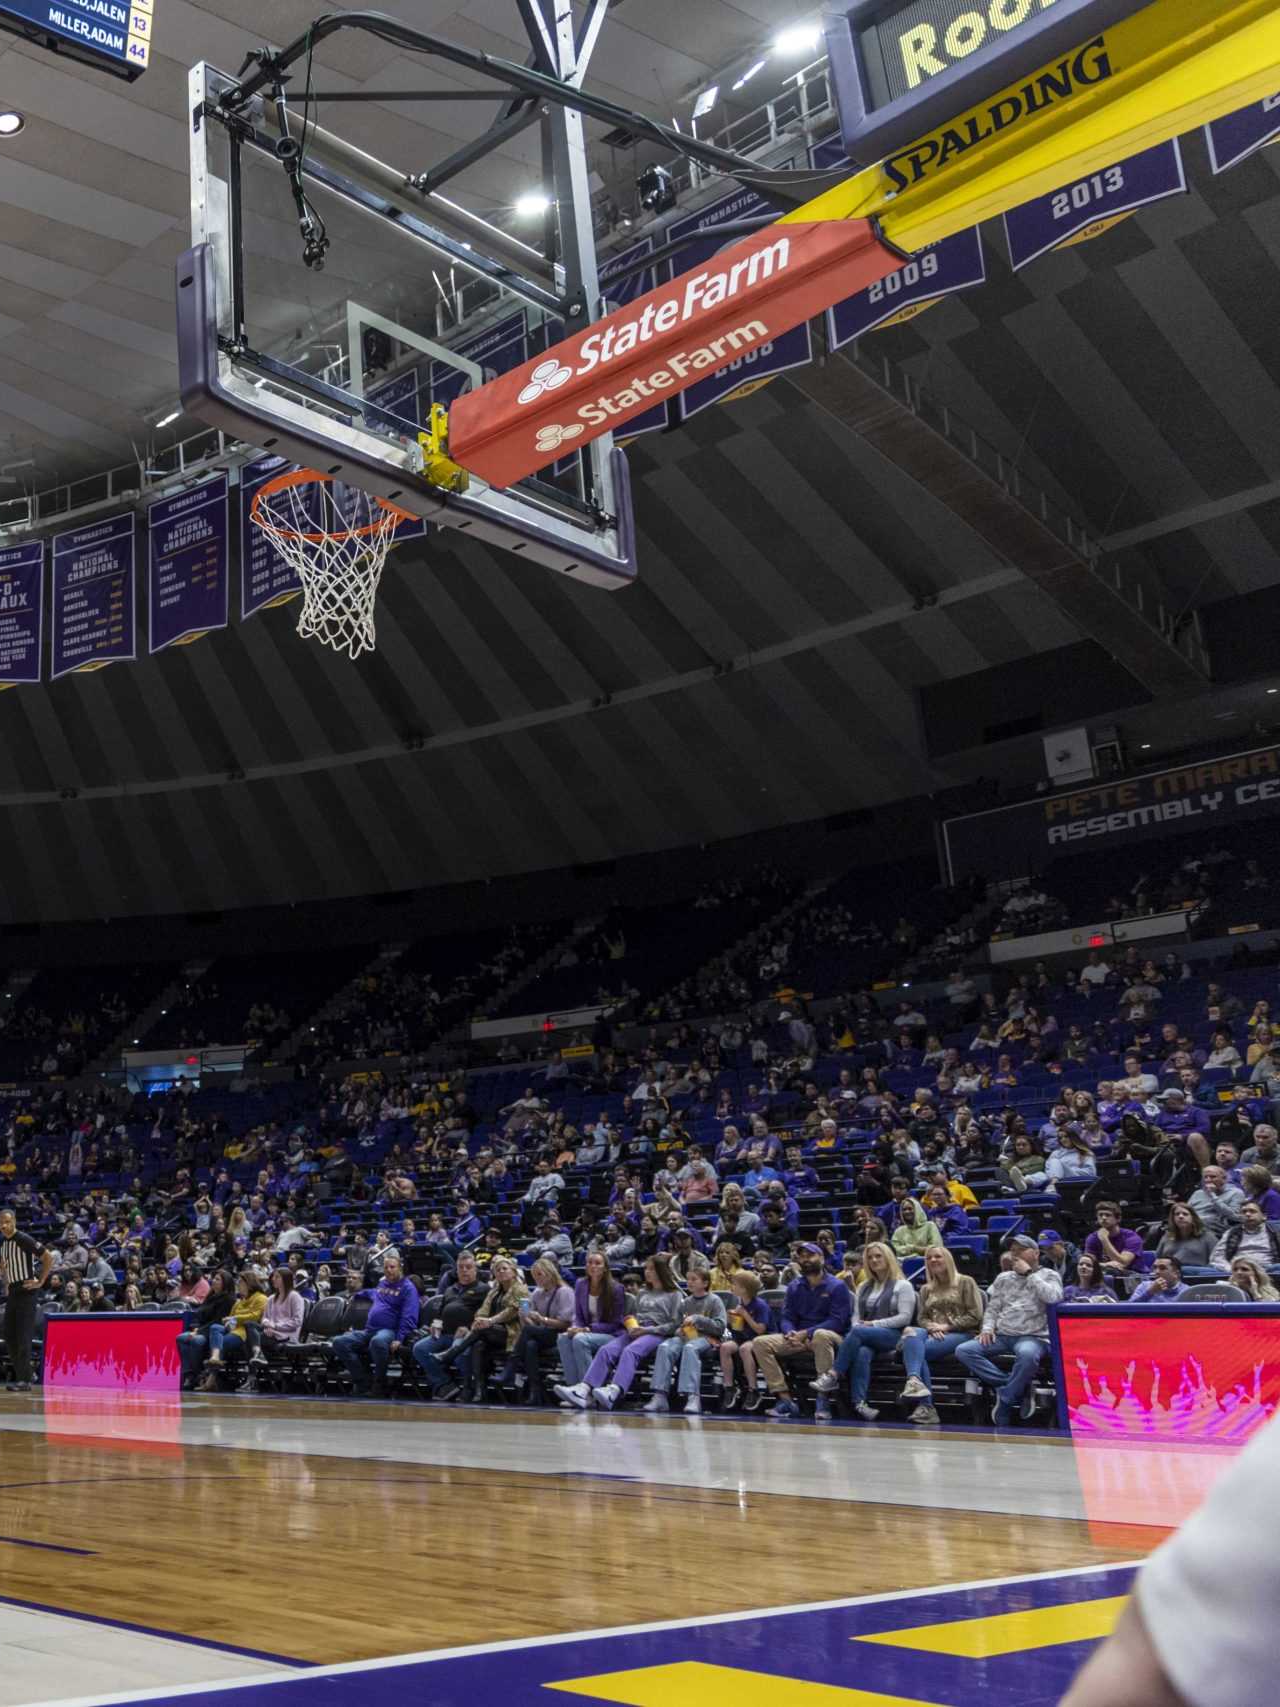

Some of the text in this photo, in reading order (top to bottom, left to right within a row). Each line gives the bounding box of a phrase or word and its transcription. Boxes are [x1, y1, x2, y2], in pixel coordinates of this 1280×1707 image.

[49, 8, 124, 50] MILLER,ADAM
[133, 16, 147, 31] 13
[129, 44, 145, 59] 44
[899, 0, 1058, 89] Roo
[881, 36, 1113, 194] SPALDING
[698, 192, 760, 231] GYMNASTICS
[1052, 167, 1125, 220] 2013
[868, 252, 939, 305] 2009
[577, 237, 790, 376] State Farm
[577, 319, 769, 426] State Farm
[163, 526, 214, 553] CHAMPIONS
[168, 519, 208, 541] NATIONAL
[67, 559, 119, 582] CHAMPIONS
[72, 552, 114, 571] NATIONAL
[1046, 780, 1137, 820] PETE
[1047, 788, 1223, 844] ASSEMBLY
